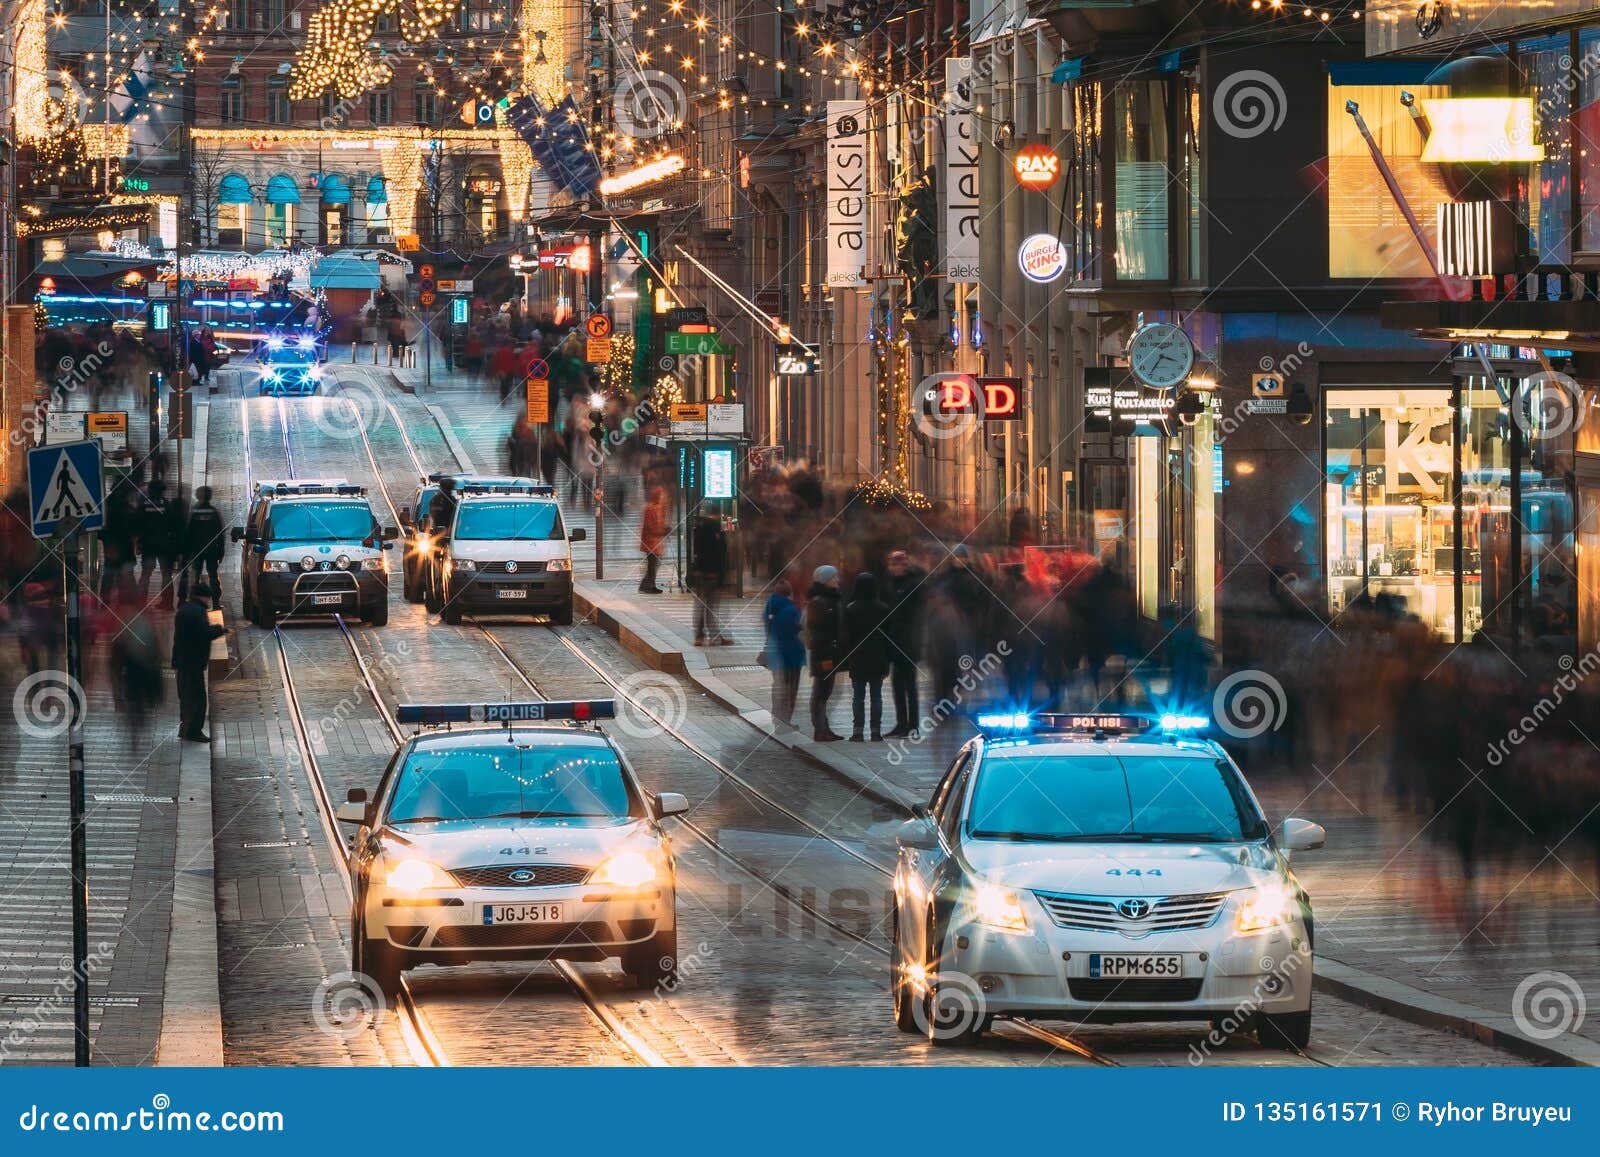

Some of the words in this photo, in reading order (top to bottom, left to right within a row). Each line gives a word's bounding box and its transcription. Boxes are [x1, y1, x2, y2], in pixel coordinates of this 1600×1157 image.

[1015, 154, 1058, 173] RAX
[829, 145, 863, 250] aleksi
[1025, 243, 1059, 261] BURGER
[1027, 252, 1060, 272] KING
[830, 271, 859, 282] aleksi
[779, 357, 808, 373] Zio
[1114, 397, 1175, 408] KULTAKELLO
[488, 705, 545, 720] POLIISI
[499, 847, 548, 855] 442
[1106, 868, 1162, 876] 444
[496, 905, 559, 922] JGJ-518
[1103, 957, 1178, 975] RPM-655
